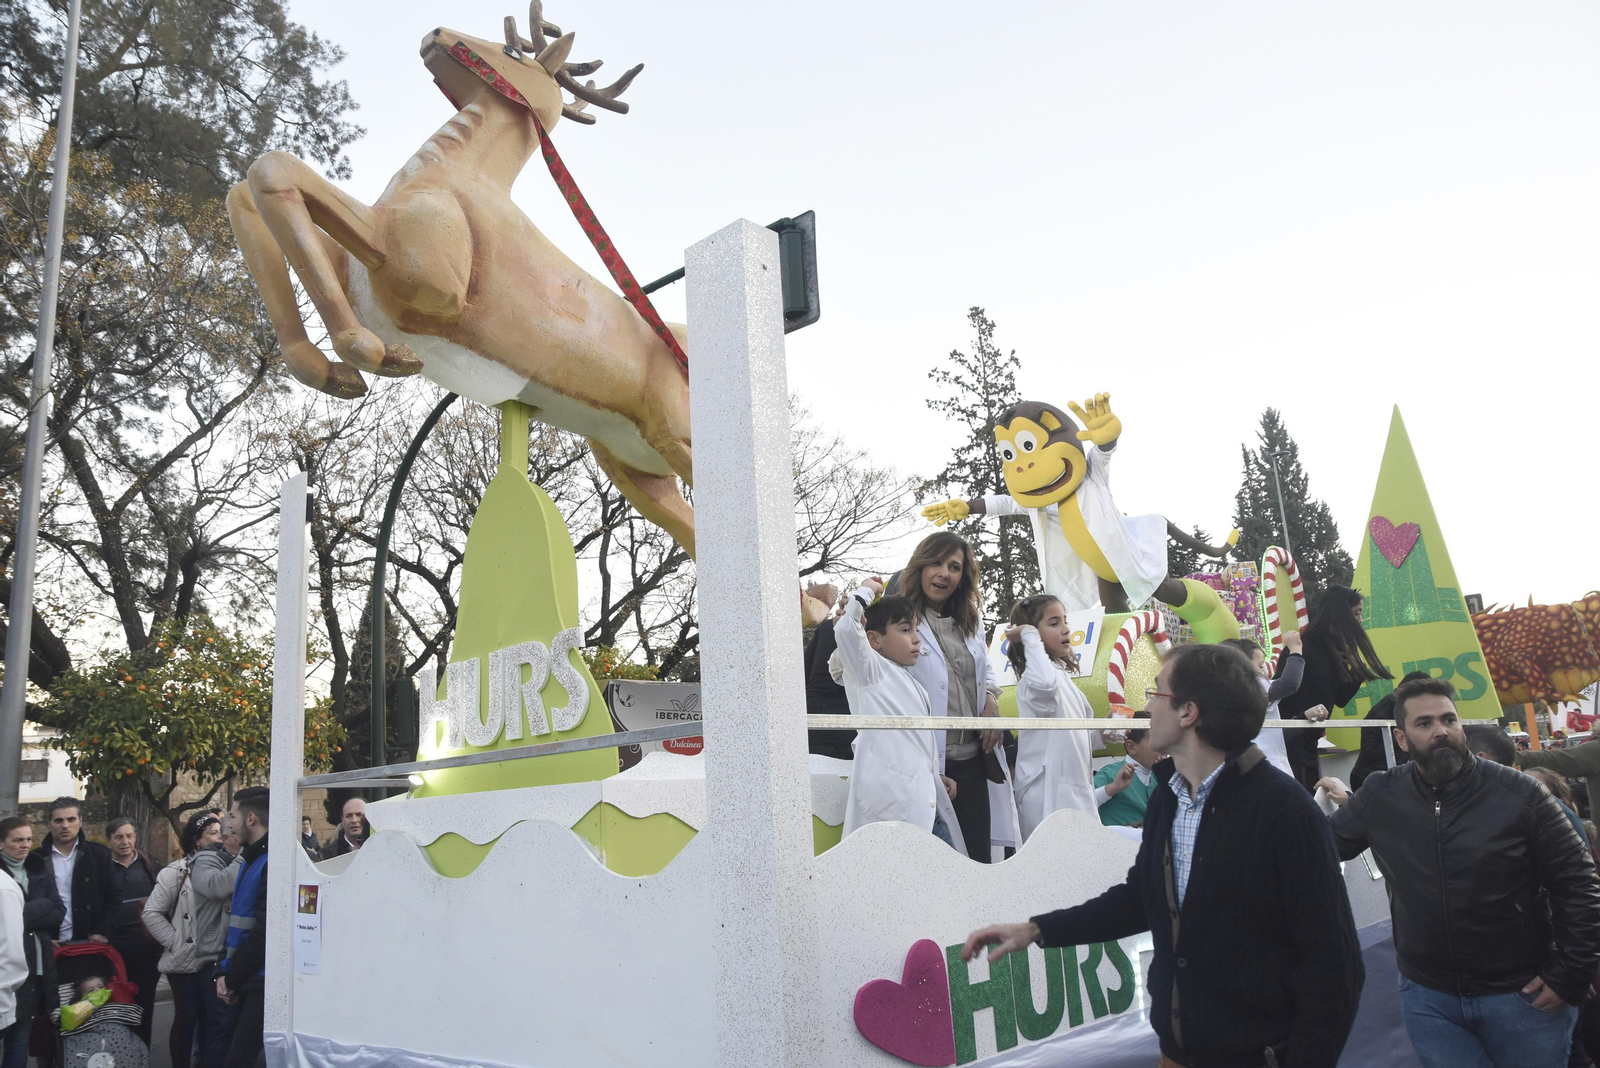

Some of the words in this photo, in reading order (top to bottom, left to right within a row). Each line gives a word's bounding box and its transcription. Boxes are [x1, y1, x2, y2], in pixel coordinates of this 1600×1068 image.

[419, 627, 590, 755] HURS
[1343, 651, 1488, 717] HRS
[669, 739, 702, 748] Dulcinea
[946, 941, 1136, 1067] HURS
